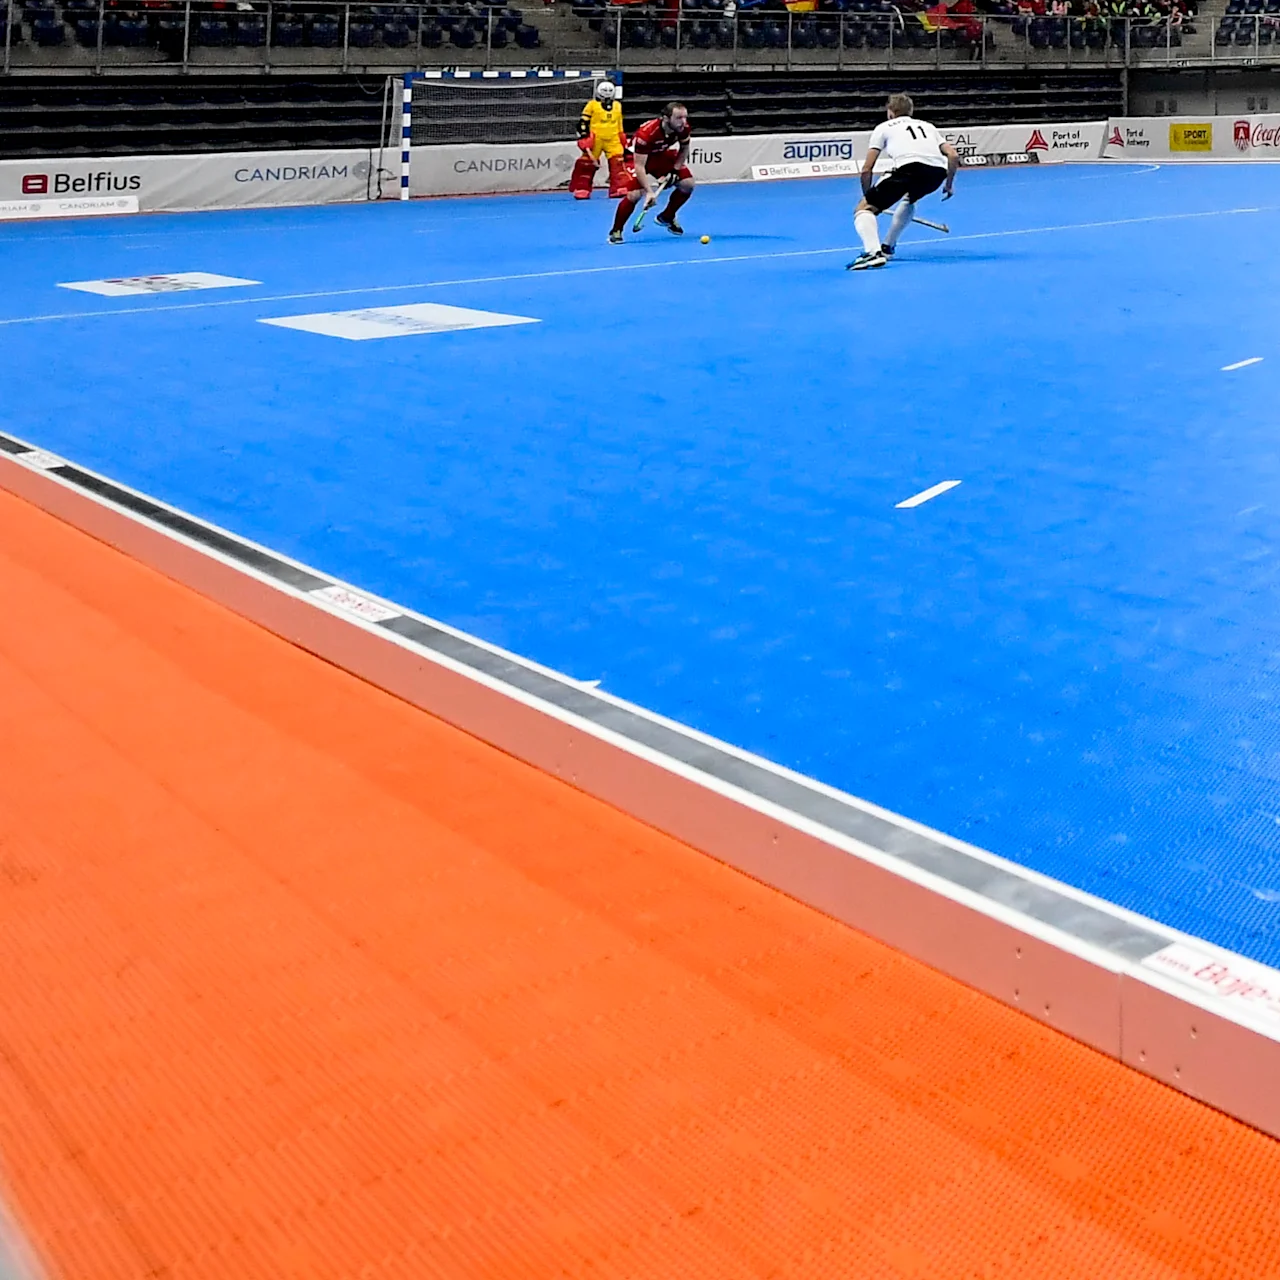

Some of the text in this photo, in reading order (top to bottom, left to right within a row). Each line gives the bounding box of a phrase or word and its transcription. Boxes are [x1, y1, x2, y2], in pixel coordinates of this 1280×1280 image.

[906, 126, 927, 140] 11
[1052, 131, 1081, 140] Port of
[783, 140, 852, 161] auping
[1052, 139, 1089, 149] Antwerp
[686, 149, 723, 164] lfius
[453, 158, 551, 174] CANDRIAM
[769, 166, 801, 176] Belfius
[821, 163, 851, 172] Belfius
[234, 166, 348, 182] CANDRIAM
[54, 172, 141, 193] Belfius
[59, 201, 115, 210] CANDRIAM
